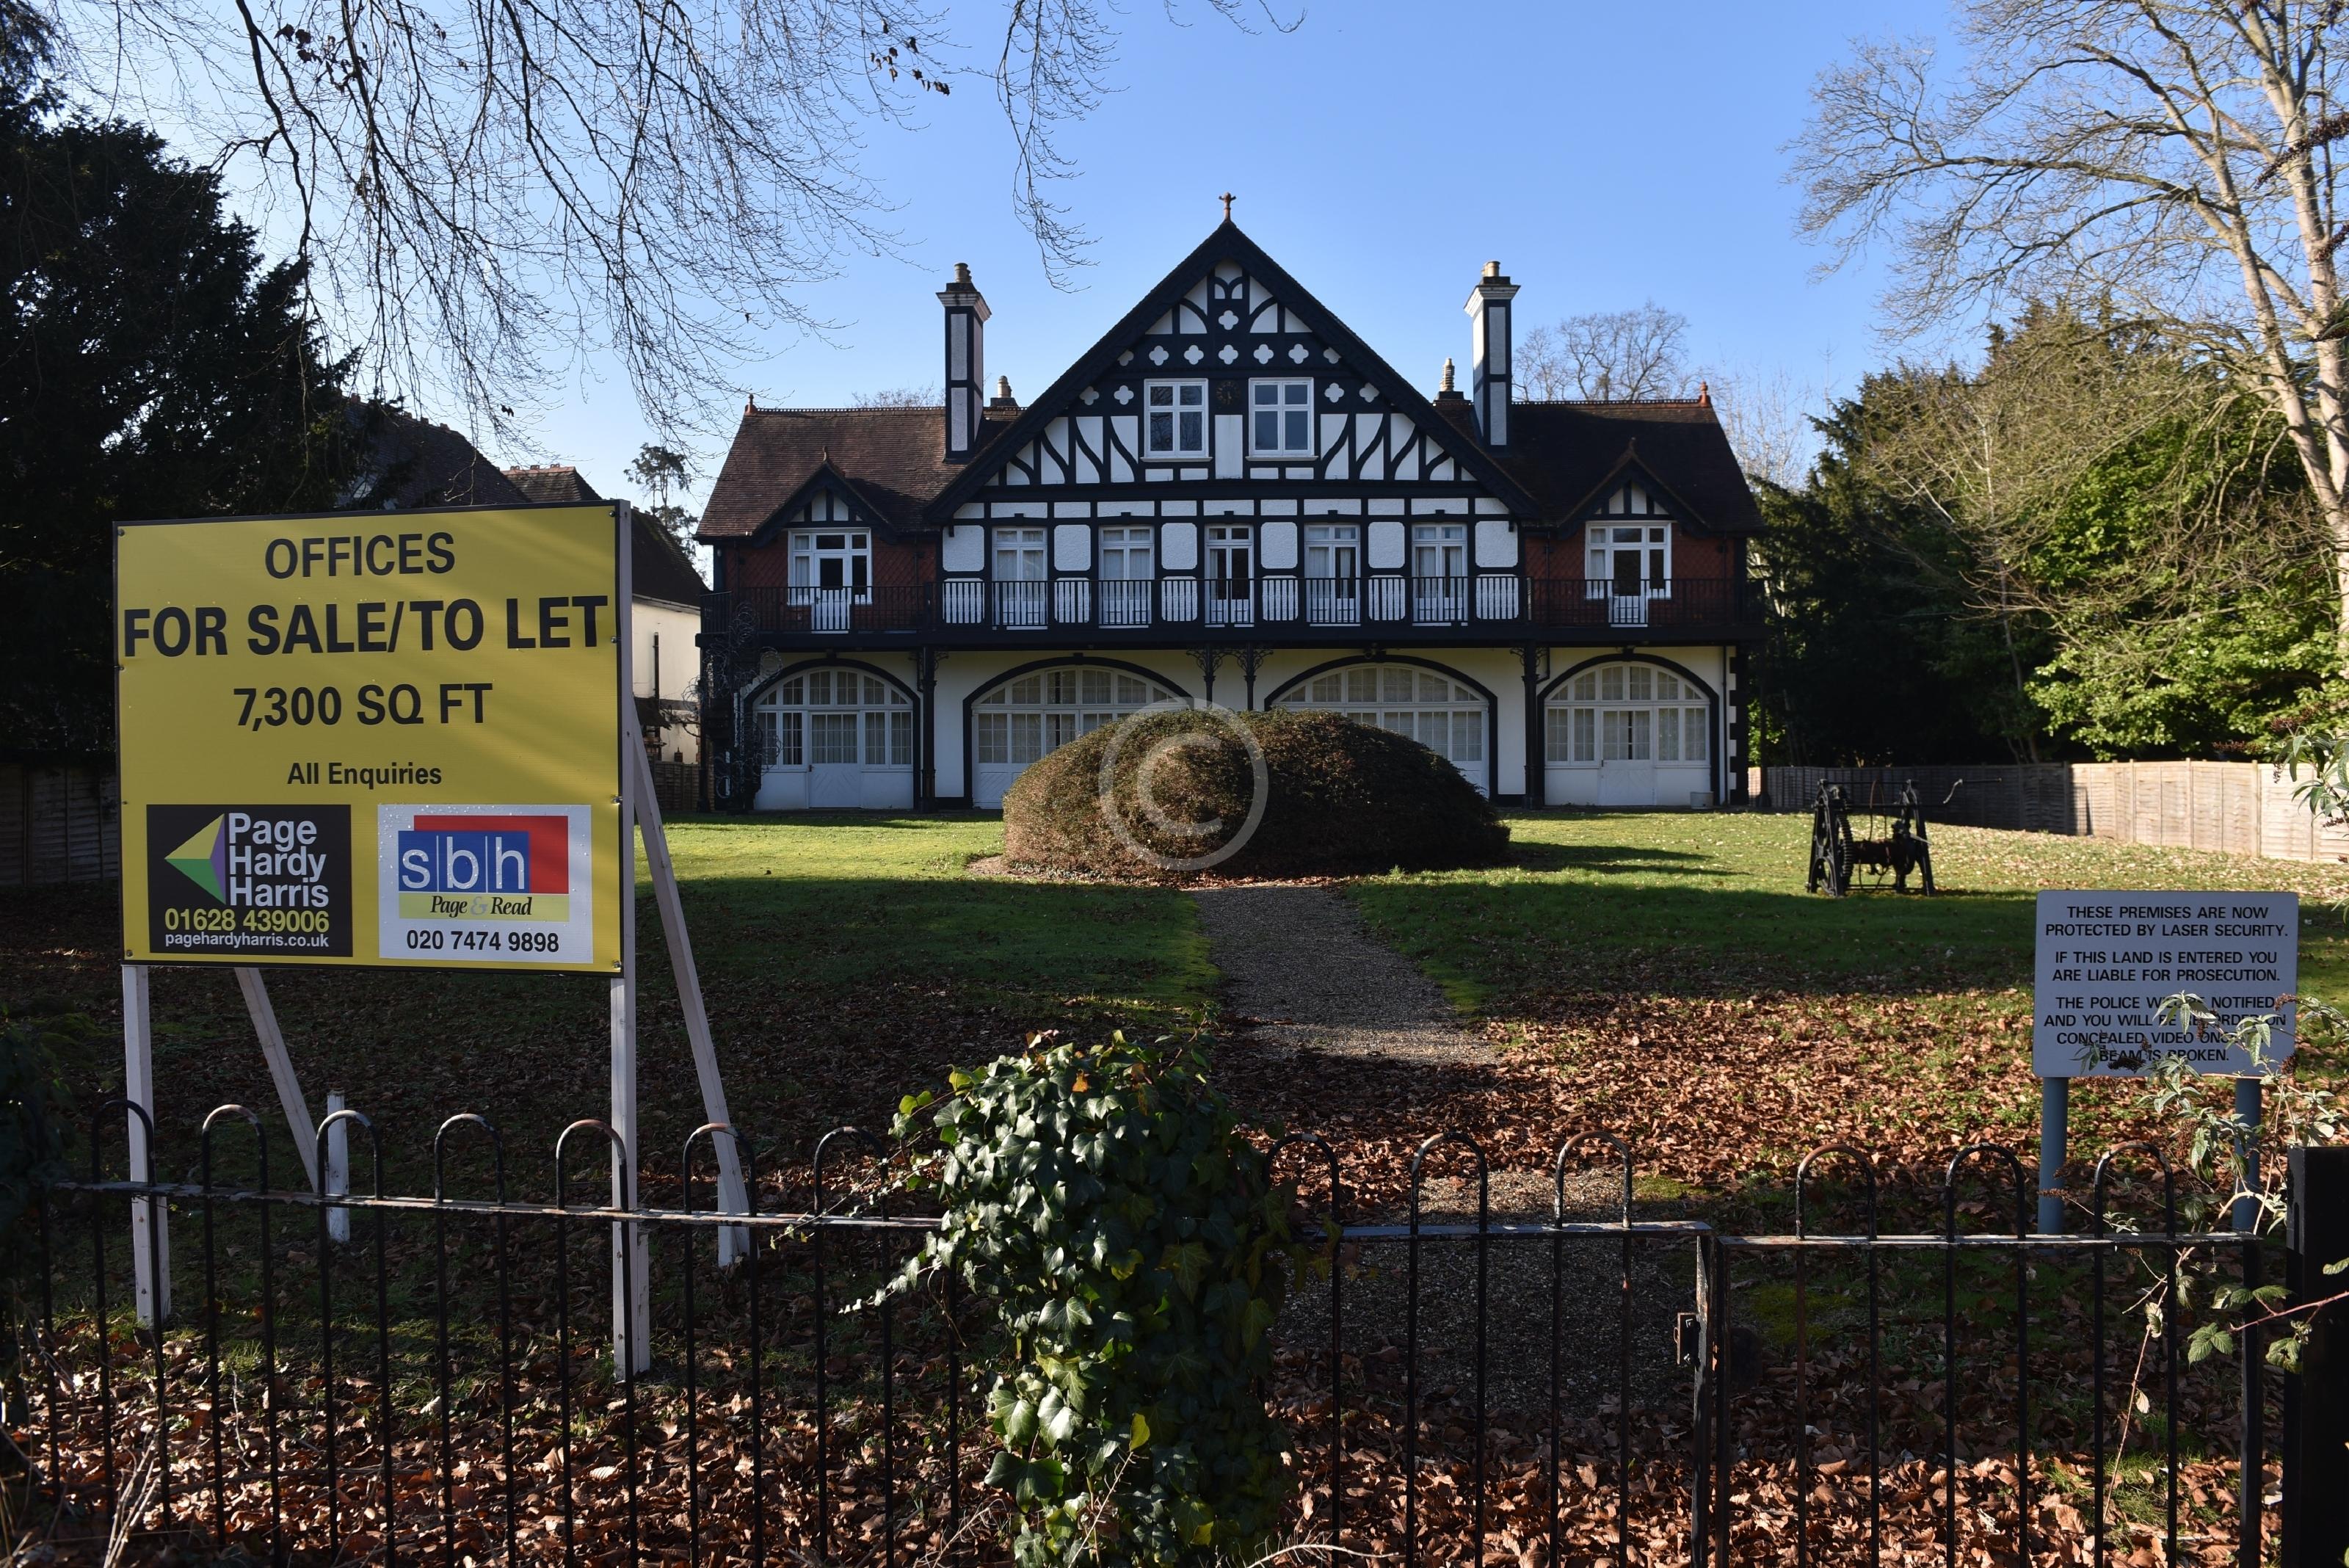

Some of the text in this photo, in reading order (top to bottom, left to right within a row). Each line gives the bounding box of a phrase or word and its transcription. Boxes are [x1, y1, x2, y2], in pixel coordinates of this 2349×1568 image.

[266, 532, 454, 578] OFFICES
[125, 595, 608, 657] FOR SALE/TO LET
[234, 683, 493, 731] 7,300 SQ FT
[288, 762, 441, 789] All Enquiries
[229, 813, 316, 852] Page
[230, 845, 326, 885] Hardy
[230, 876, 328, 907] Harris
[430, 896, 467, 916] Page
[490, 897, 532, 915] Read
[2067, 907, 2268, 918] THESE PREMISES ARE NOW
[165, 908, 330, 932] 01628 439006
[2046, 924, 2287, 936] PROTECTED BY LASER SECURITY.
[165, 932, 330, 948] pagehardyharris.co.uk
[407, 930, 559, 952] 020 7474 9898
[2056, 951, 2276, 963] IF THIS LAND IS ENTERED YOU
[2052, 969, 2280, 981] ARE LIABLE FOR PROSECUTION.
[2055, 997, 2083, 1009] THE
[2091, 997, 2140, 1009] POLICE
[2146, 996, 2182, 1009] WLL
[2211, 996, 2274, 1009] NOTIFIED
[2044, 1015, 2076, 1026] AND
[2083, 1015, 2110, 1026] YOU
[2118, 1015, 2152, 1026] WILL
[2057, 1032, 2144, 1045] CONCEALED
[2151, 1032, 2193, 1043] VIDEO
[2099, 1050, 2141, 1062] BEAM
[2149, 1049, 2162, 1061] IS
